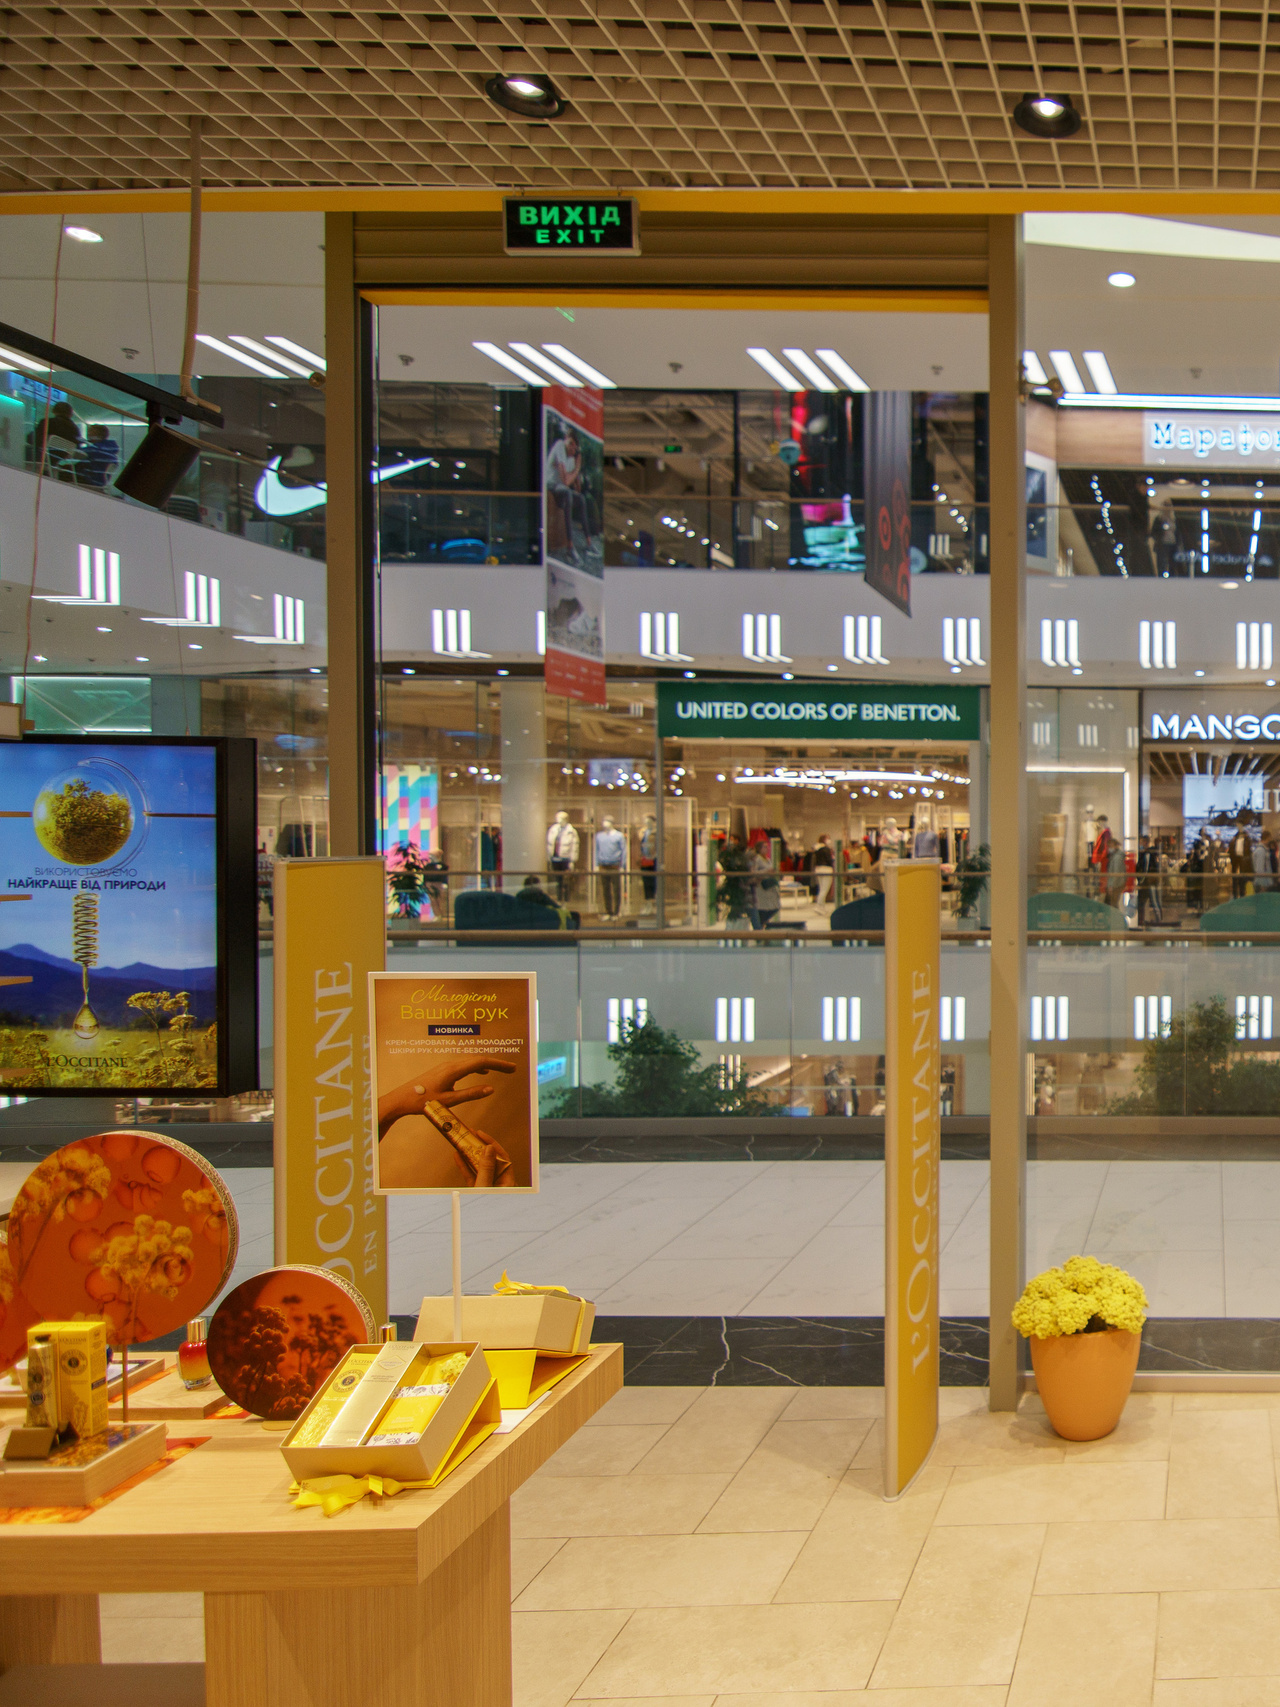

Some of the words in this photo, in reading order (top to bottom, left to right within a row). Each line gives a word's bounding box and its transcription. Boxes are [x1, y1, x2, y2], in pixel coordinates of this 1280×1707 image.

[519, 205, 621, 226] ВИХІД
[535, 229, 605, 244] EXIT
[676, 701, 748, 719] UNITED
[750, 702, 828, 720] COLORS
[829, 703, 857, 721] OF
[860, 704, 961, 721] BENETTON.
[34, 867, 138, 878] ВИКОРИСТОВУЄМО
[7, 877, 78, 890] НАЙКРАЩЕ
[80, 879, 101, 891] ВІД
[104, 880, 166, 891] ПРИРОДИ
[411, 984, 497, 1009] Молодість
[401, 1005, 467, 1020] Ваших
[474, 1006, 509, 1022] рук
[46, 1054, 128, 1068] L'OCCITANE
[315, 961, 355, 1283] CCITANE
[906, 963, 932, 1376] L'OCCITANE
[364, 1232, 378, 1275] EN
